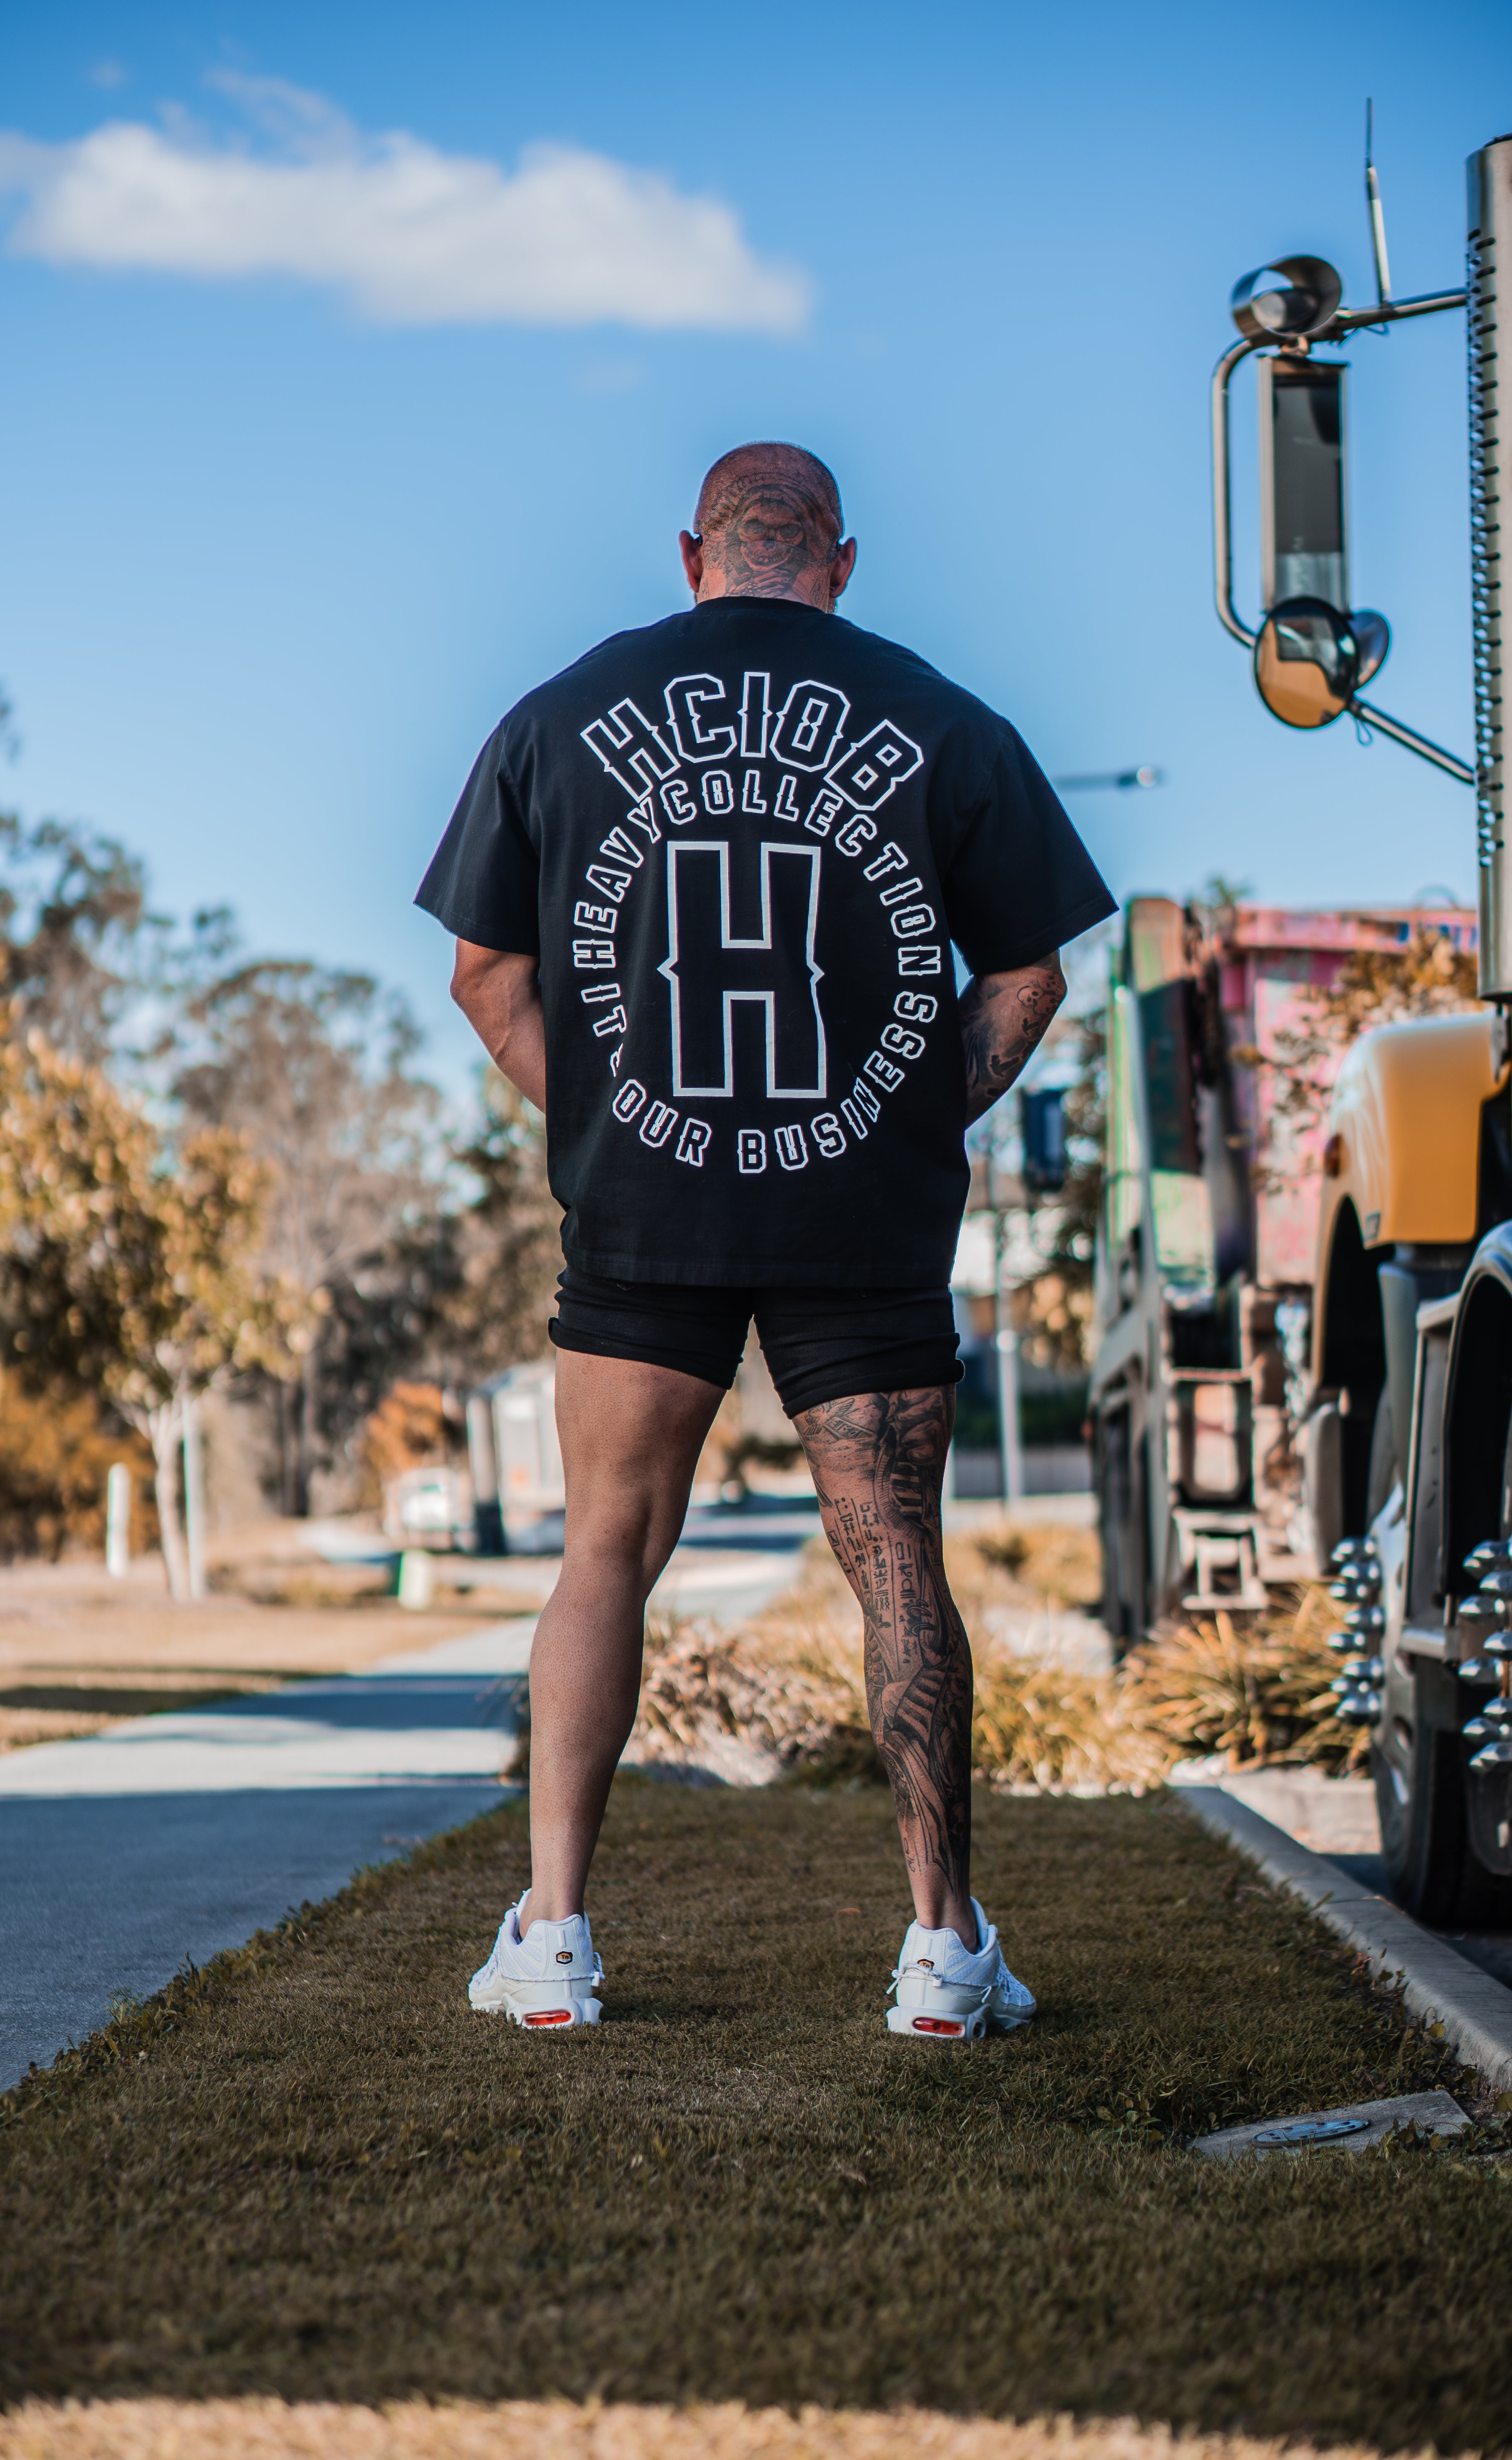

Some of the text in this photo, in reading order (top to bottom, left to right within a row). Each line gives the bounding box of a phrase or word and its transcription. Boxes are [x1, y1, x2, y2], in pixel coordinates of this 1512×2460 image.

[572, 770, 941, 976] HEAVY COLLECTION
[656, 840, 827, 1099] H
[612, 1079, 712, 1167] OUR
[737, 991, 938, 1173] BUSINESS
